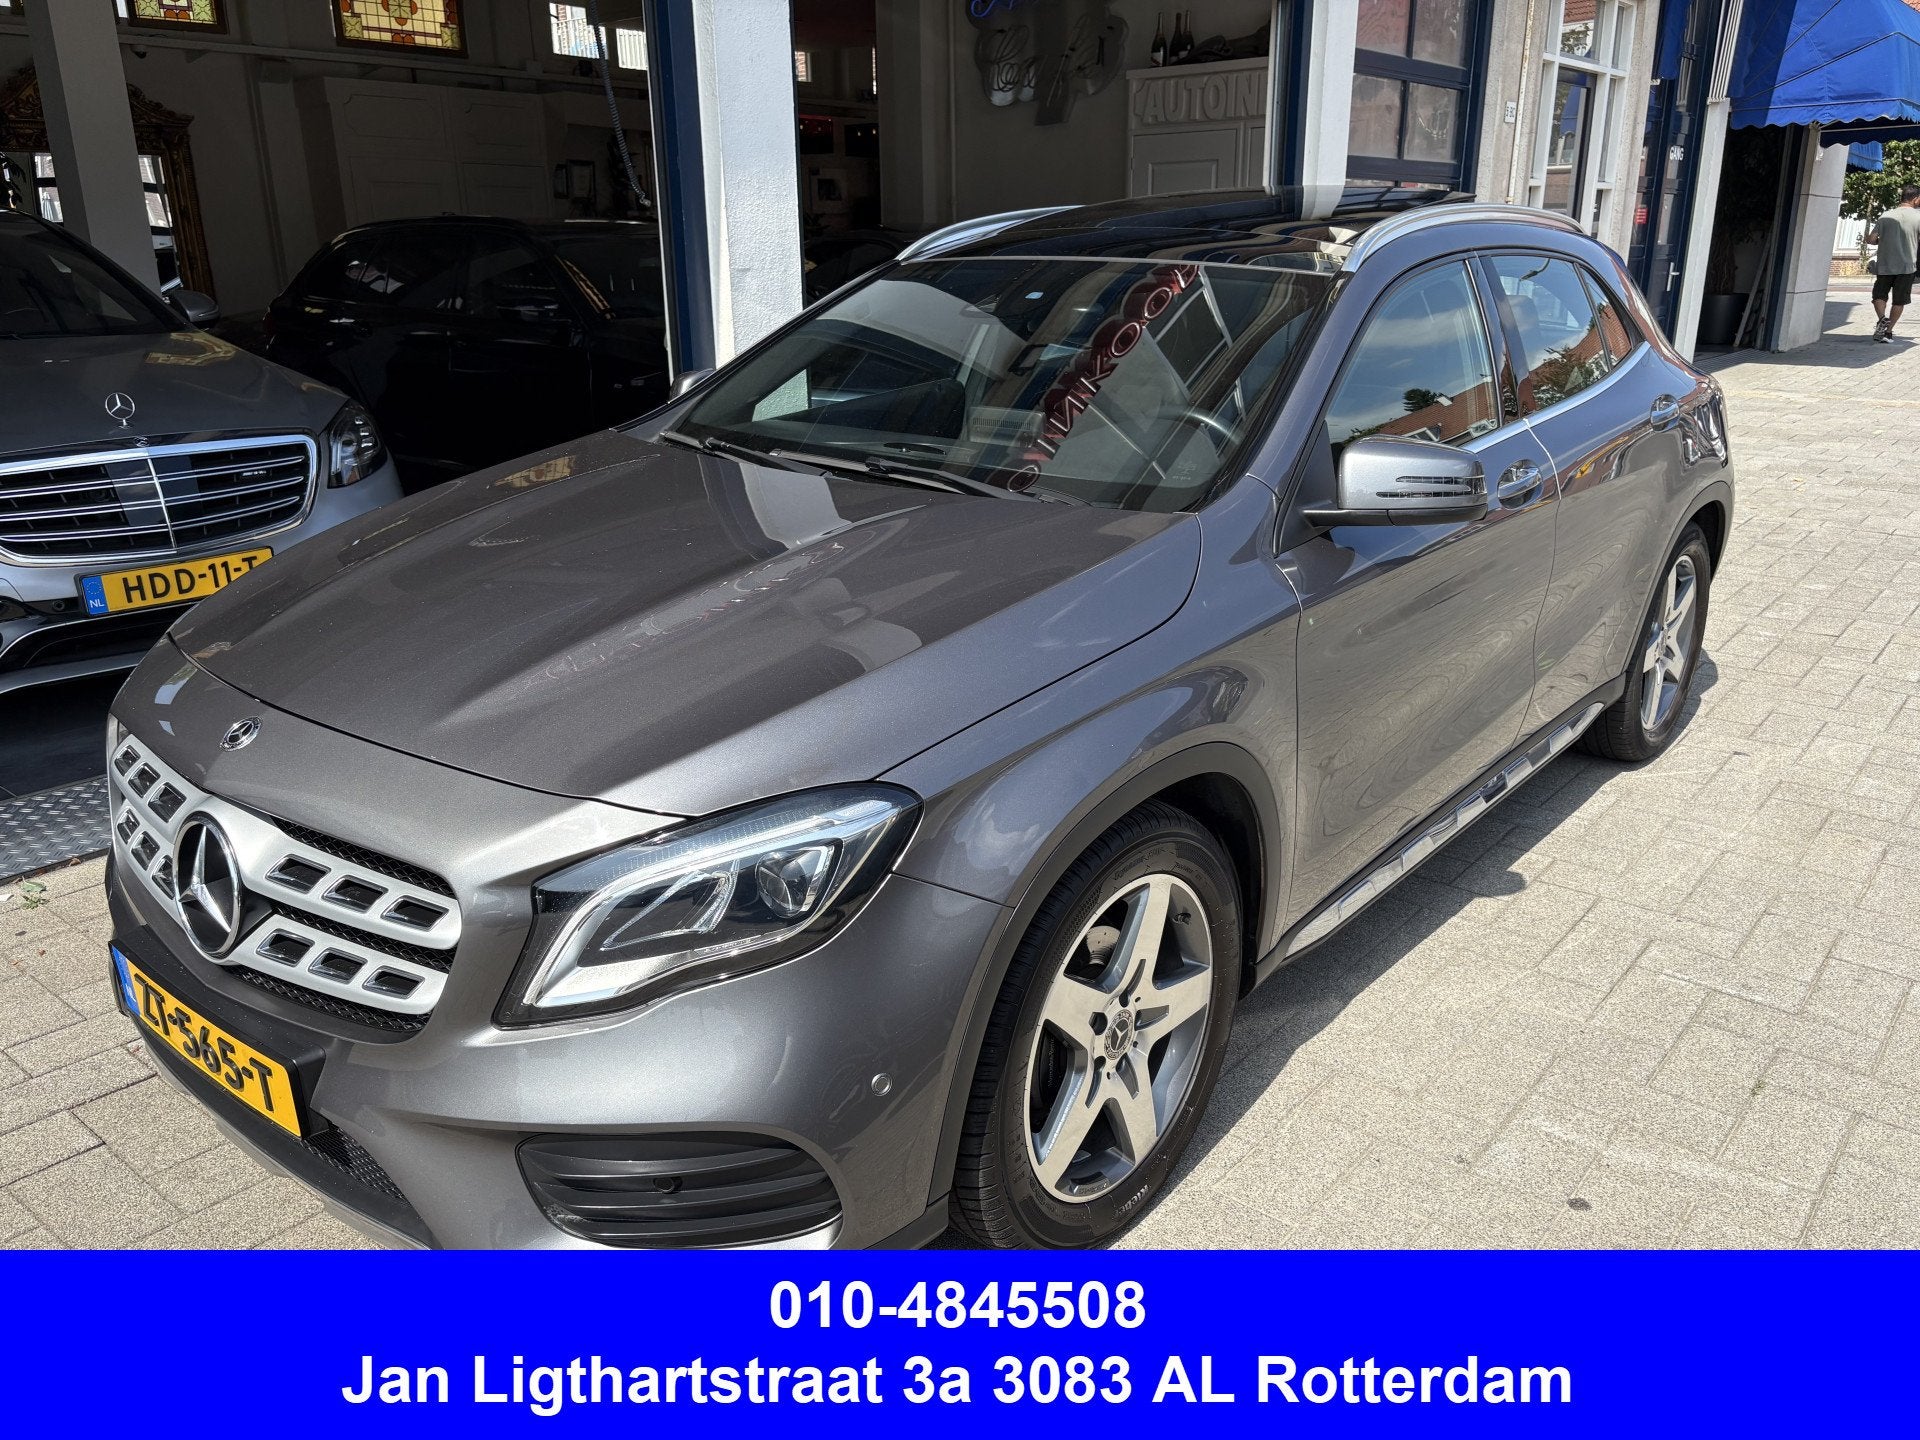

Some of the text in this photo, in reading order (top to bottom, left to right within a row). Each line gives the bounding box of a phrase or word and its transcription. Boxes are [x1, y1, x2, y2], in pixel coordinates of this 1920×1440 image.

[122, 556, 258, 603] HDD-11-T
[89, 598, 105, 609] NL
[134, 973, 275, 1113] ZT-565-T
